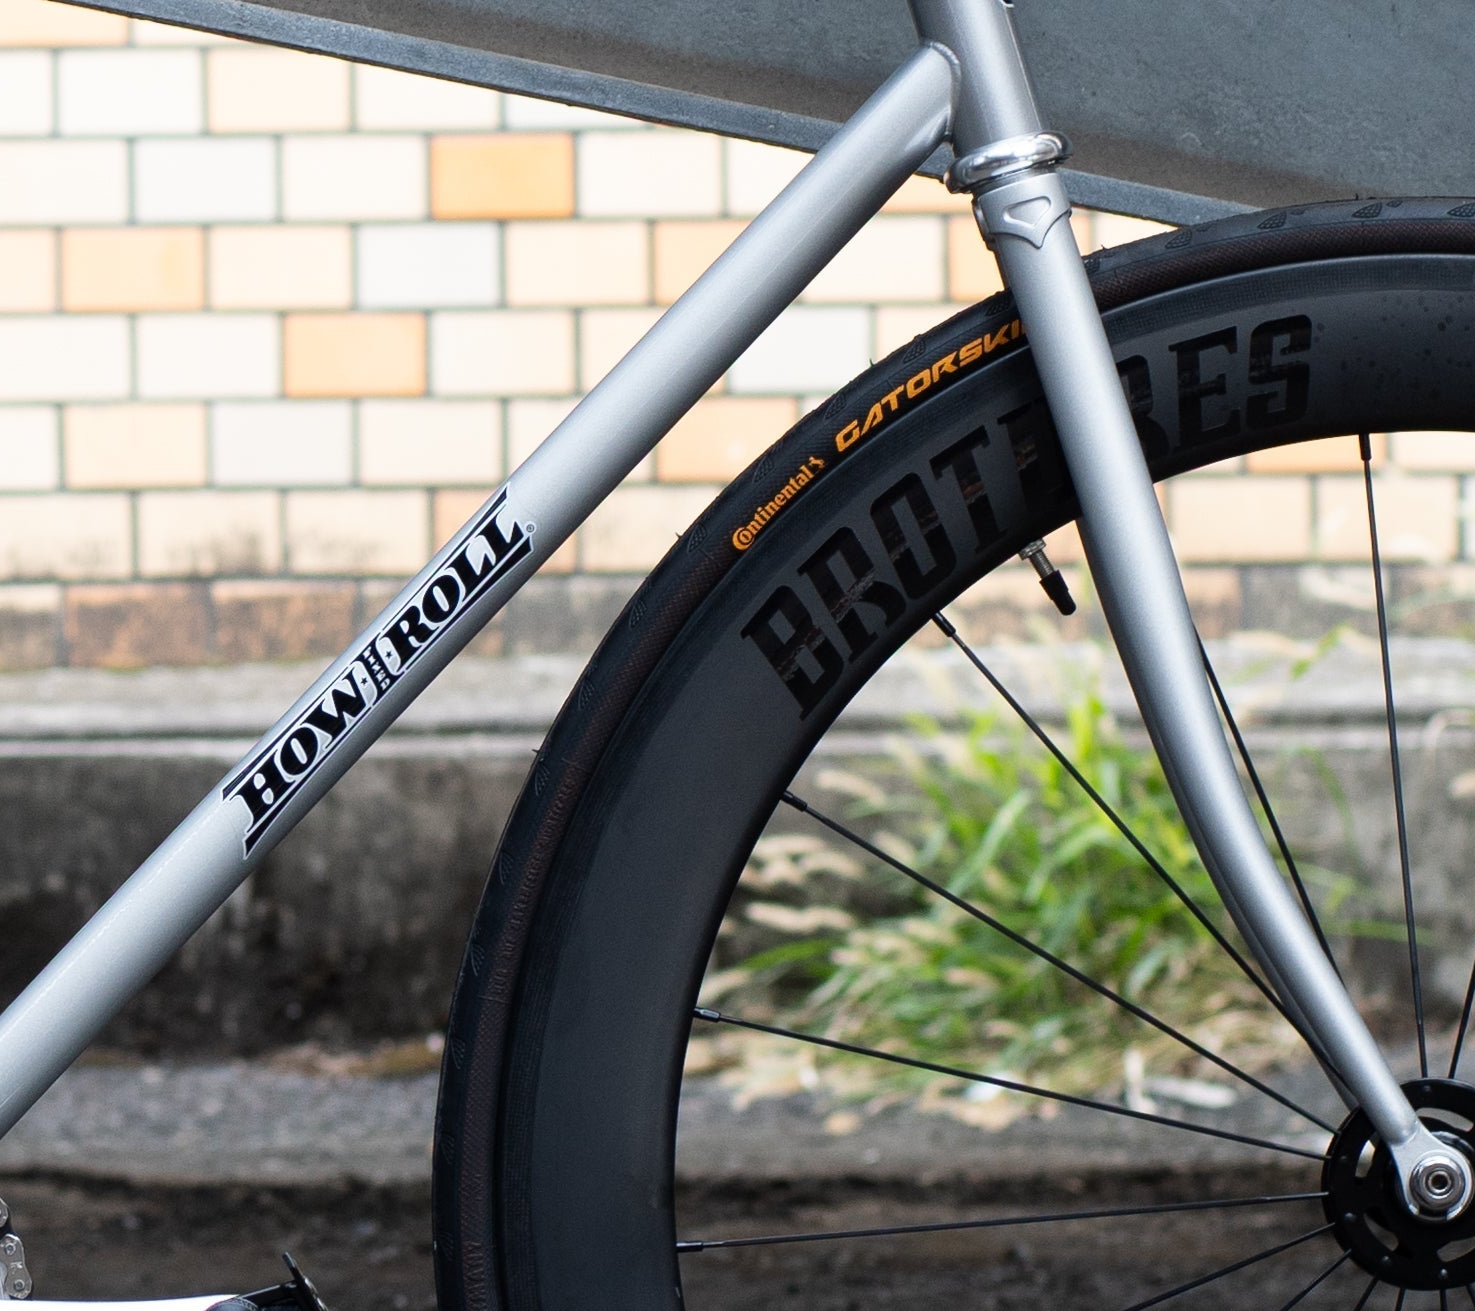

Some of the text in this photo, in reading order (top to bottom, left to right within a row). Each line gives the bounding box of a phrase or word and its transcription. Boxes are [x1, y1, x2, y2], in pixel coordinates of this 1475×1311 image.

[732, 320, 1026, 551] Continental GATORSKI
[740, 314, 1312, 721] BROTES
[229, 662, 368, 832] HOW
[384, 519, 525, 671] ROLL
